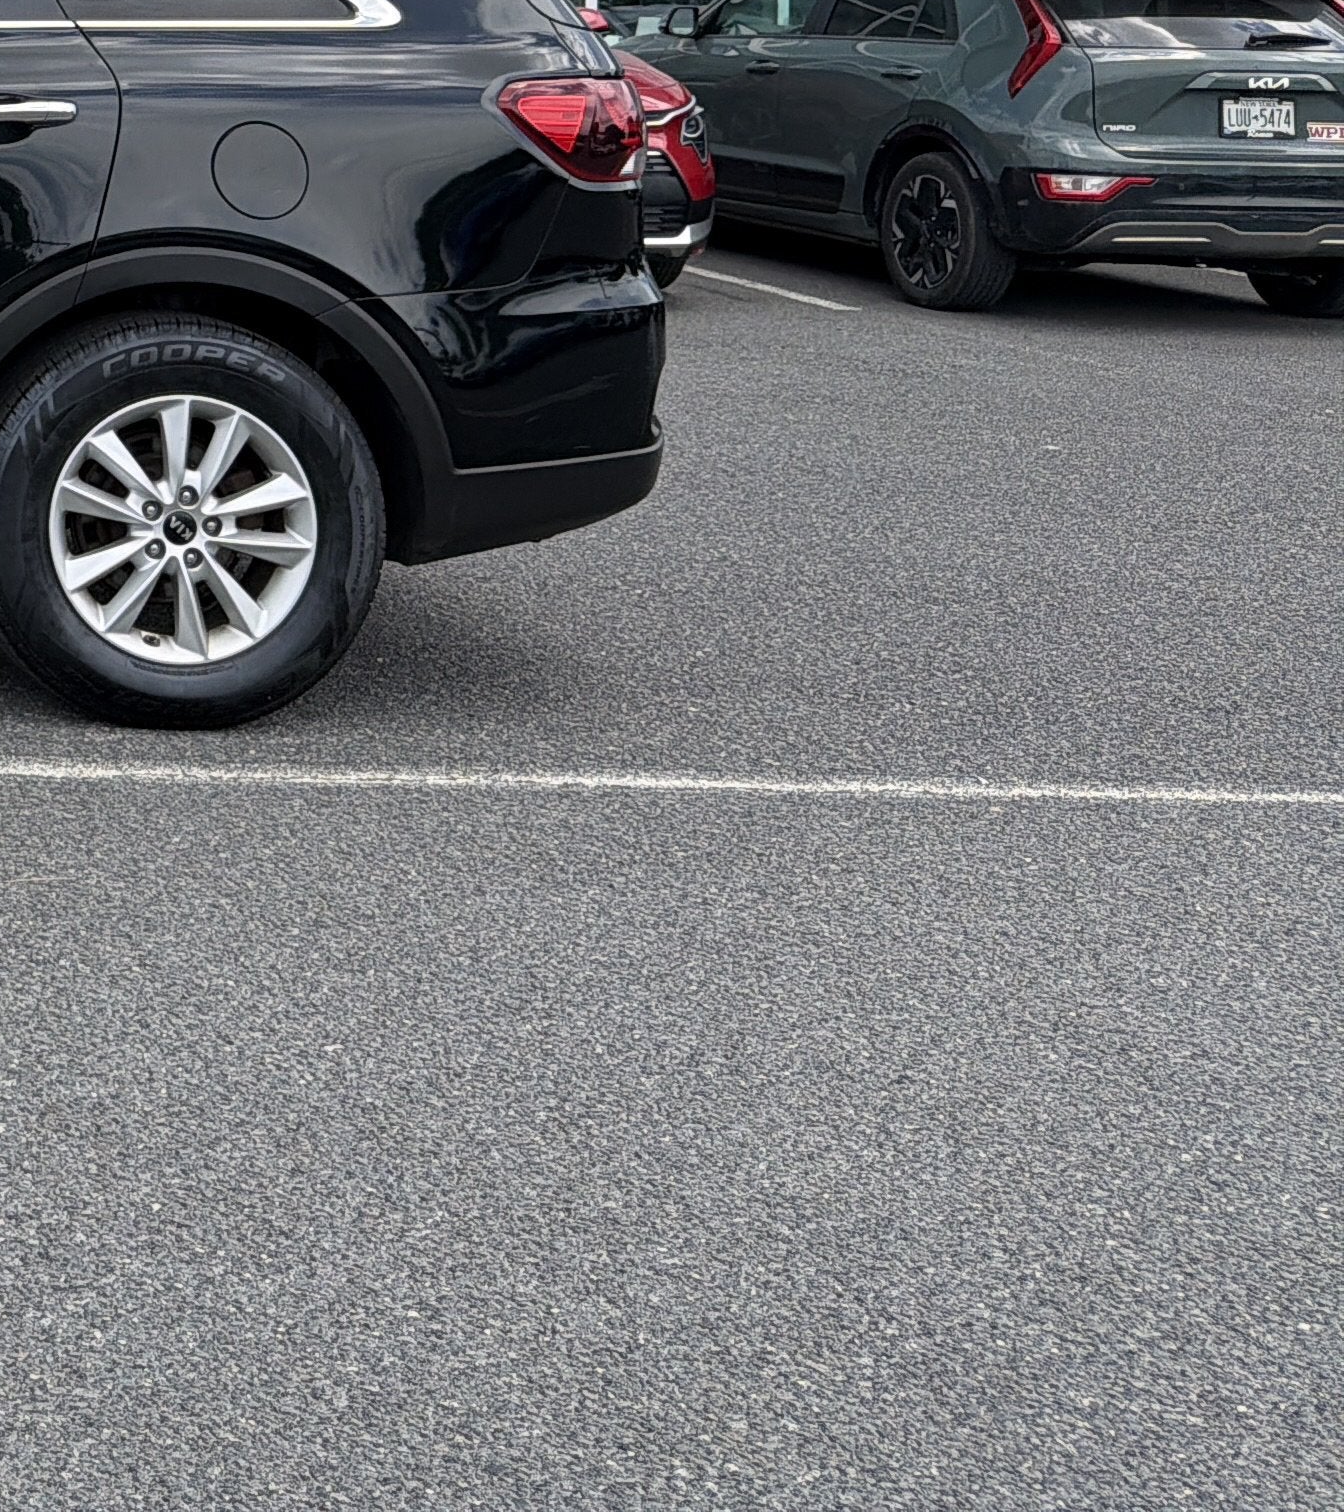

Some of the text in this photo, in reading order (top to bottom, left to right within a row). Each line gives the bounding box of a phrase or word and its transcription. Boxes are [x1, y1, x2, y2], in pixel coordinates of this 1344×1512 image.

[1248, 77, 1290, 89] KIA
[102, 343, 287, 383] COOPER
[169, 515, 194, 541] KIA
